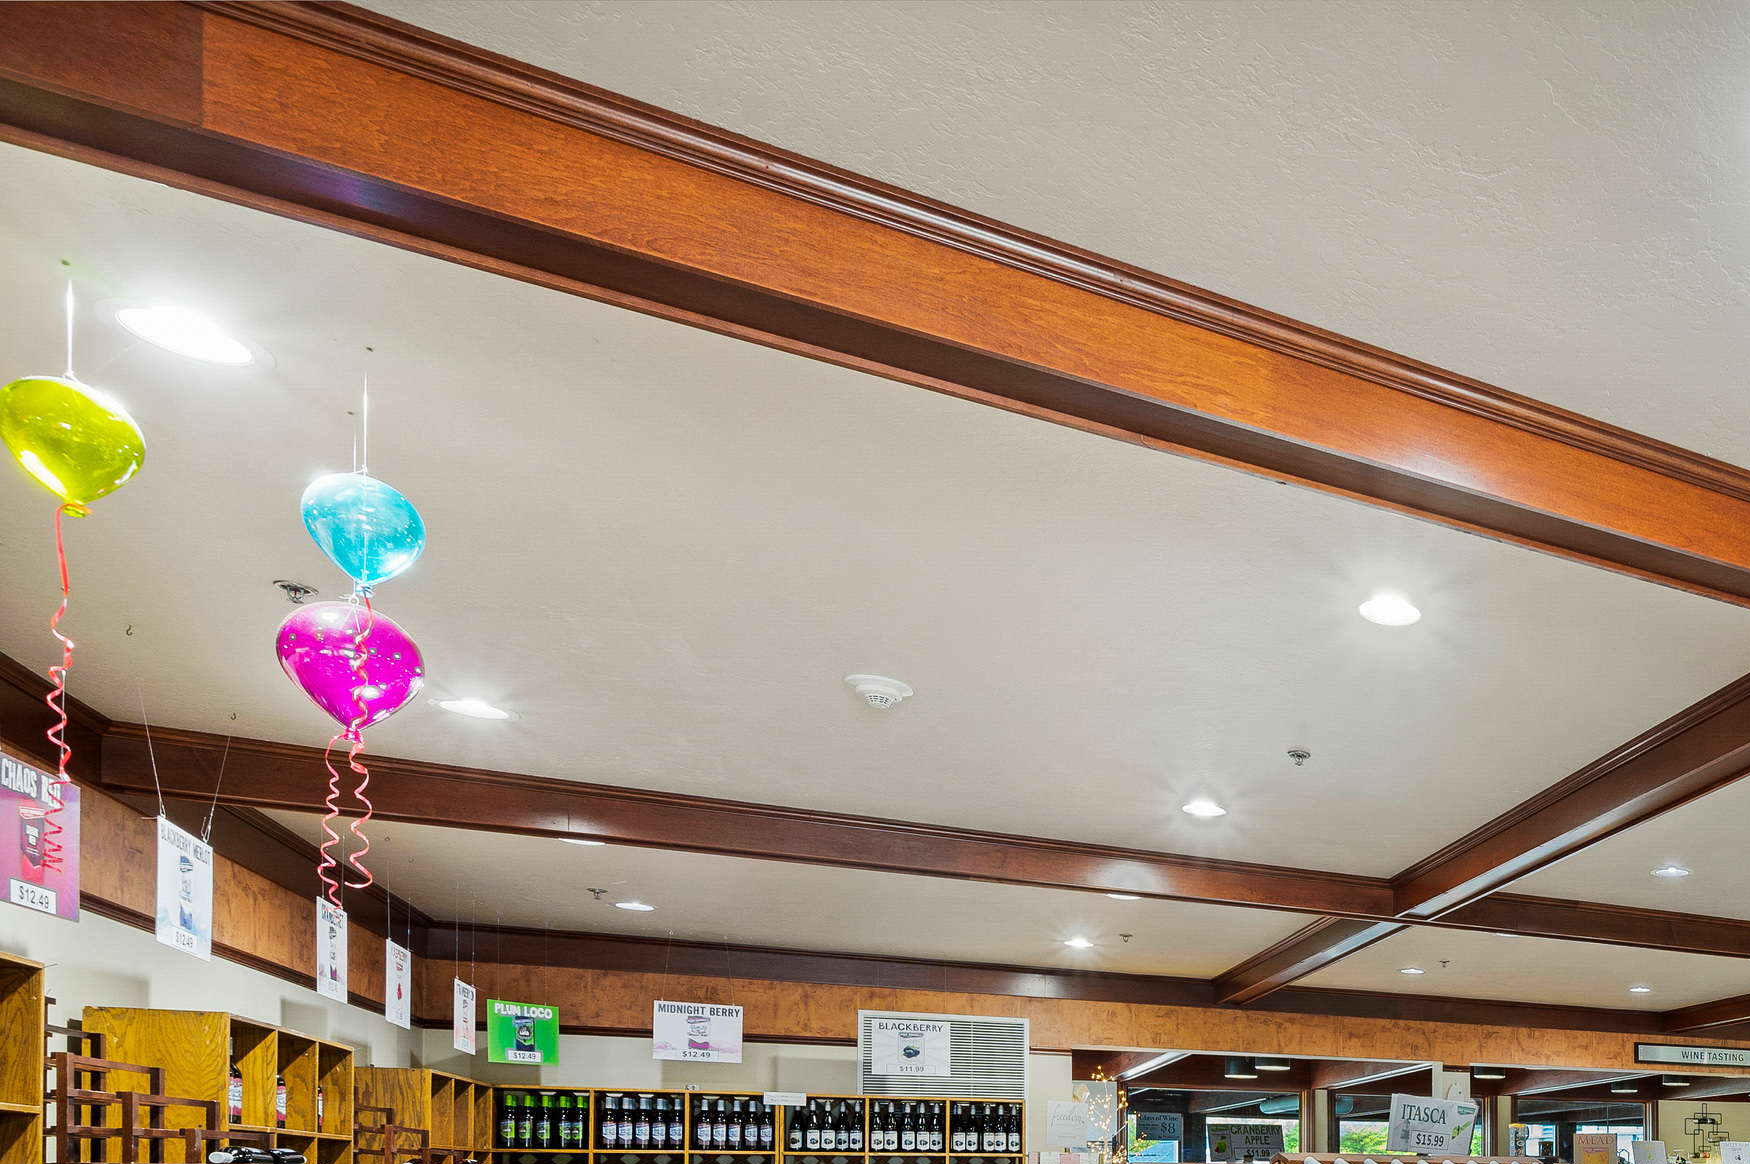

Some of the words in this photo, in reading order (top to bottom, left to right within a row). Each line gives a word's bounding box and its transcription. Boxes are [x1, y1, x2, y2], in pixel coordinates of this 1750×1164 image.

[1, 757, 37, 799] CHAOS
[160, 823, 191, 855] BLACKBERRY
[19, 885, 49, 909] $12.49
[494, 1002, 521, 1015] PLUM
[524, 1005, 553, 1019] LOCO
[658, 1003, 706, 1015] MIDNIGHT
[709, 1006, 741, 1018] BERRY
[878, 1021, 944, 1033] BLACKBERRY
[513, 1052, 536, 1060] $12.49
[682, 1050, 711, 1058] $12.49
[1681, 1050, 1705, 1060] WINE
[1708, 1052, 1744, 1062] TASTING
[899, 1065, 925, 1073] $11.99
[1050, 1104, 1085, 1127] freedom
[1401, 1103, 1447, 1125] ITASCA
[1160, 1122, 1176, 1134] $8
[1230, 1125, 1280, 1135] CRANBERRY
[1244, 1136, 1270, 1145] APPLE
[1415, 1132, 1445, 1147] $15.99
[1577, 1135, 1614, 1145] MEAD
[1246, 1149, 1270, 1158] $11.99
